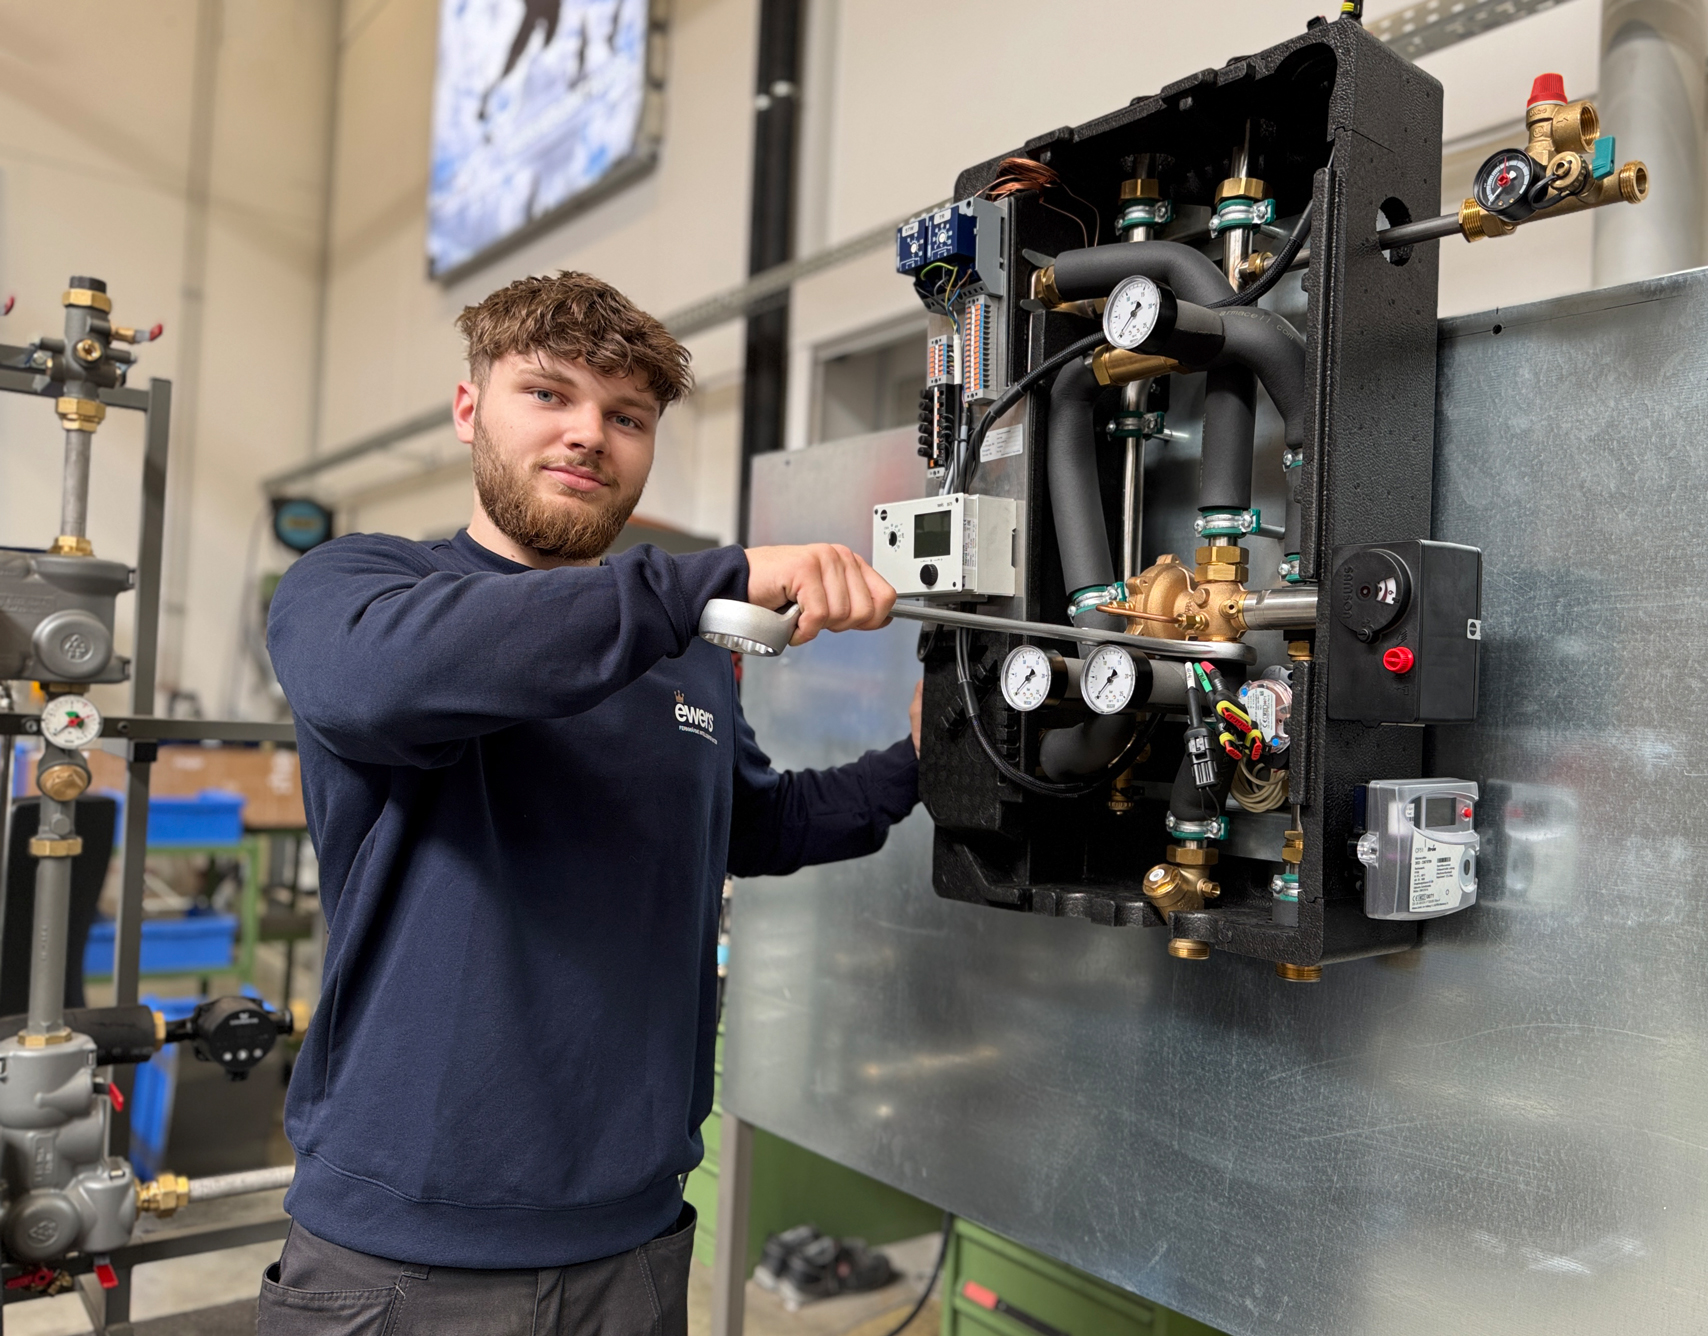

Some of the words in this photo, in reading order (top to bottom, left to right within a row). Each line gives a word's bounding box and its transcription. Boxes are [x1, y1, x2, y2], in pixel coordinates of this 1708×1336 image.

[939, 213, 946, 221] TR
[1218, 310, 1294, 341] armacell.com
[675, 703, 714, 732] ewers
